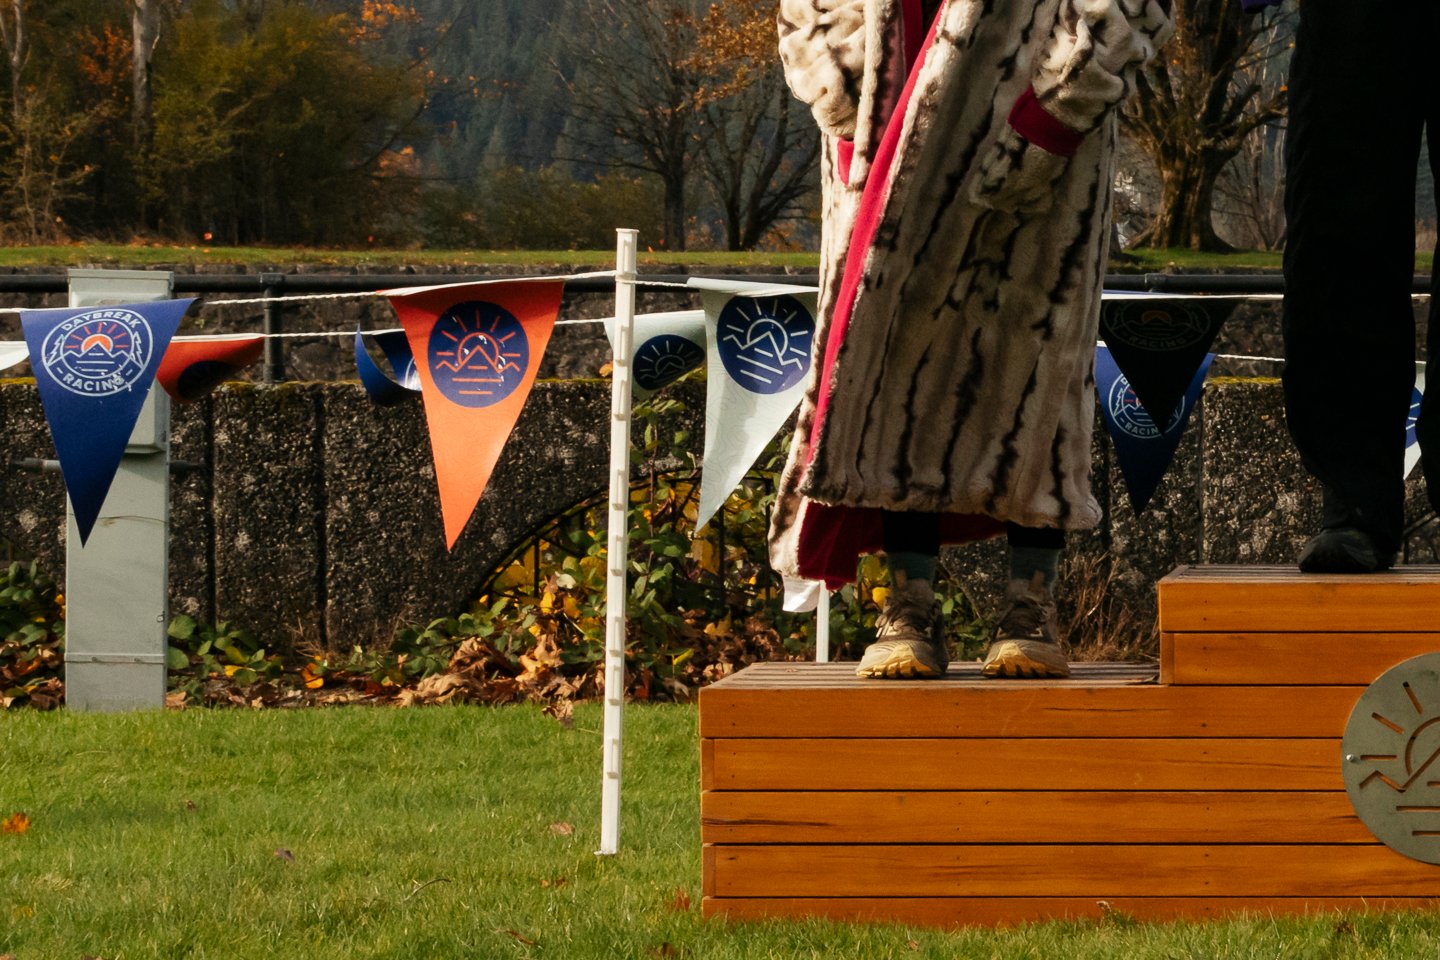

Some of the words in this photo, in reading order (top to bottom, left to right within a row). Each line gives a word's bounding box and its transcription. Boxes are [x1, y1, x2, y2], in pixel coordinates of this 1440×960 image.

[61, 311, 141, 331] DAYBREAK
[63, 373, 125, 391] RACING
[1124, 422, 1159, 435] RACIN
